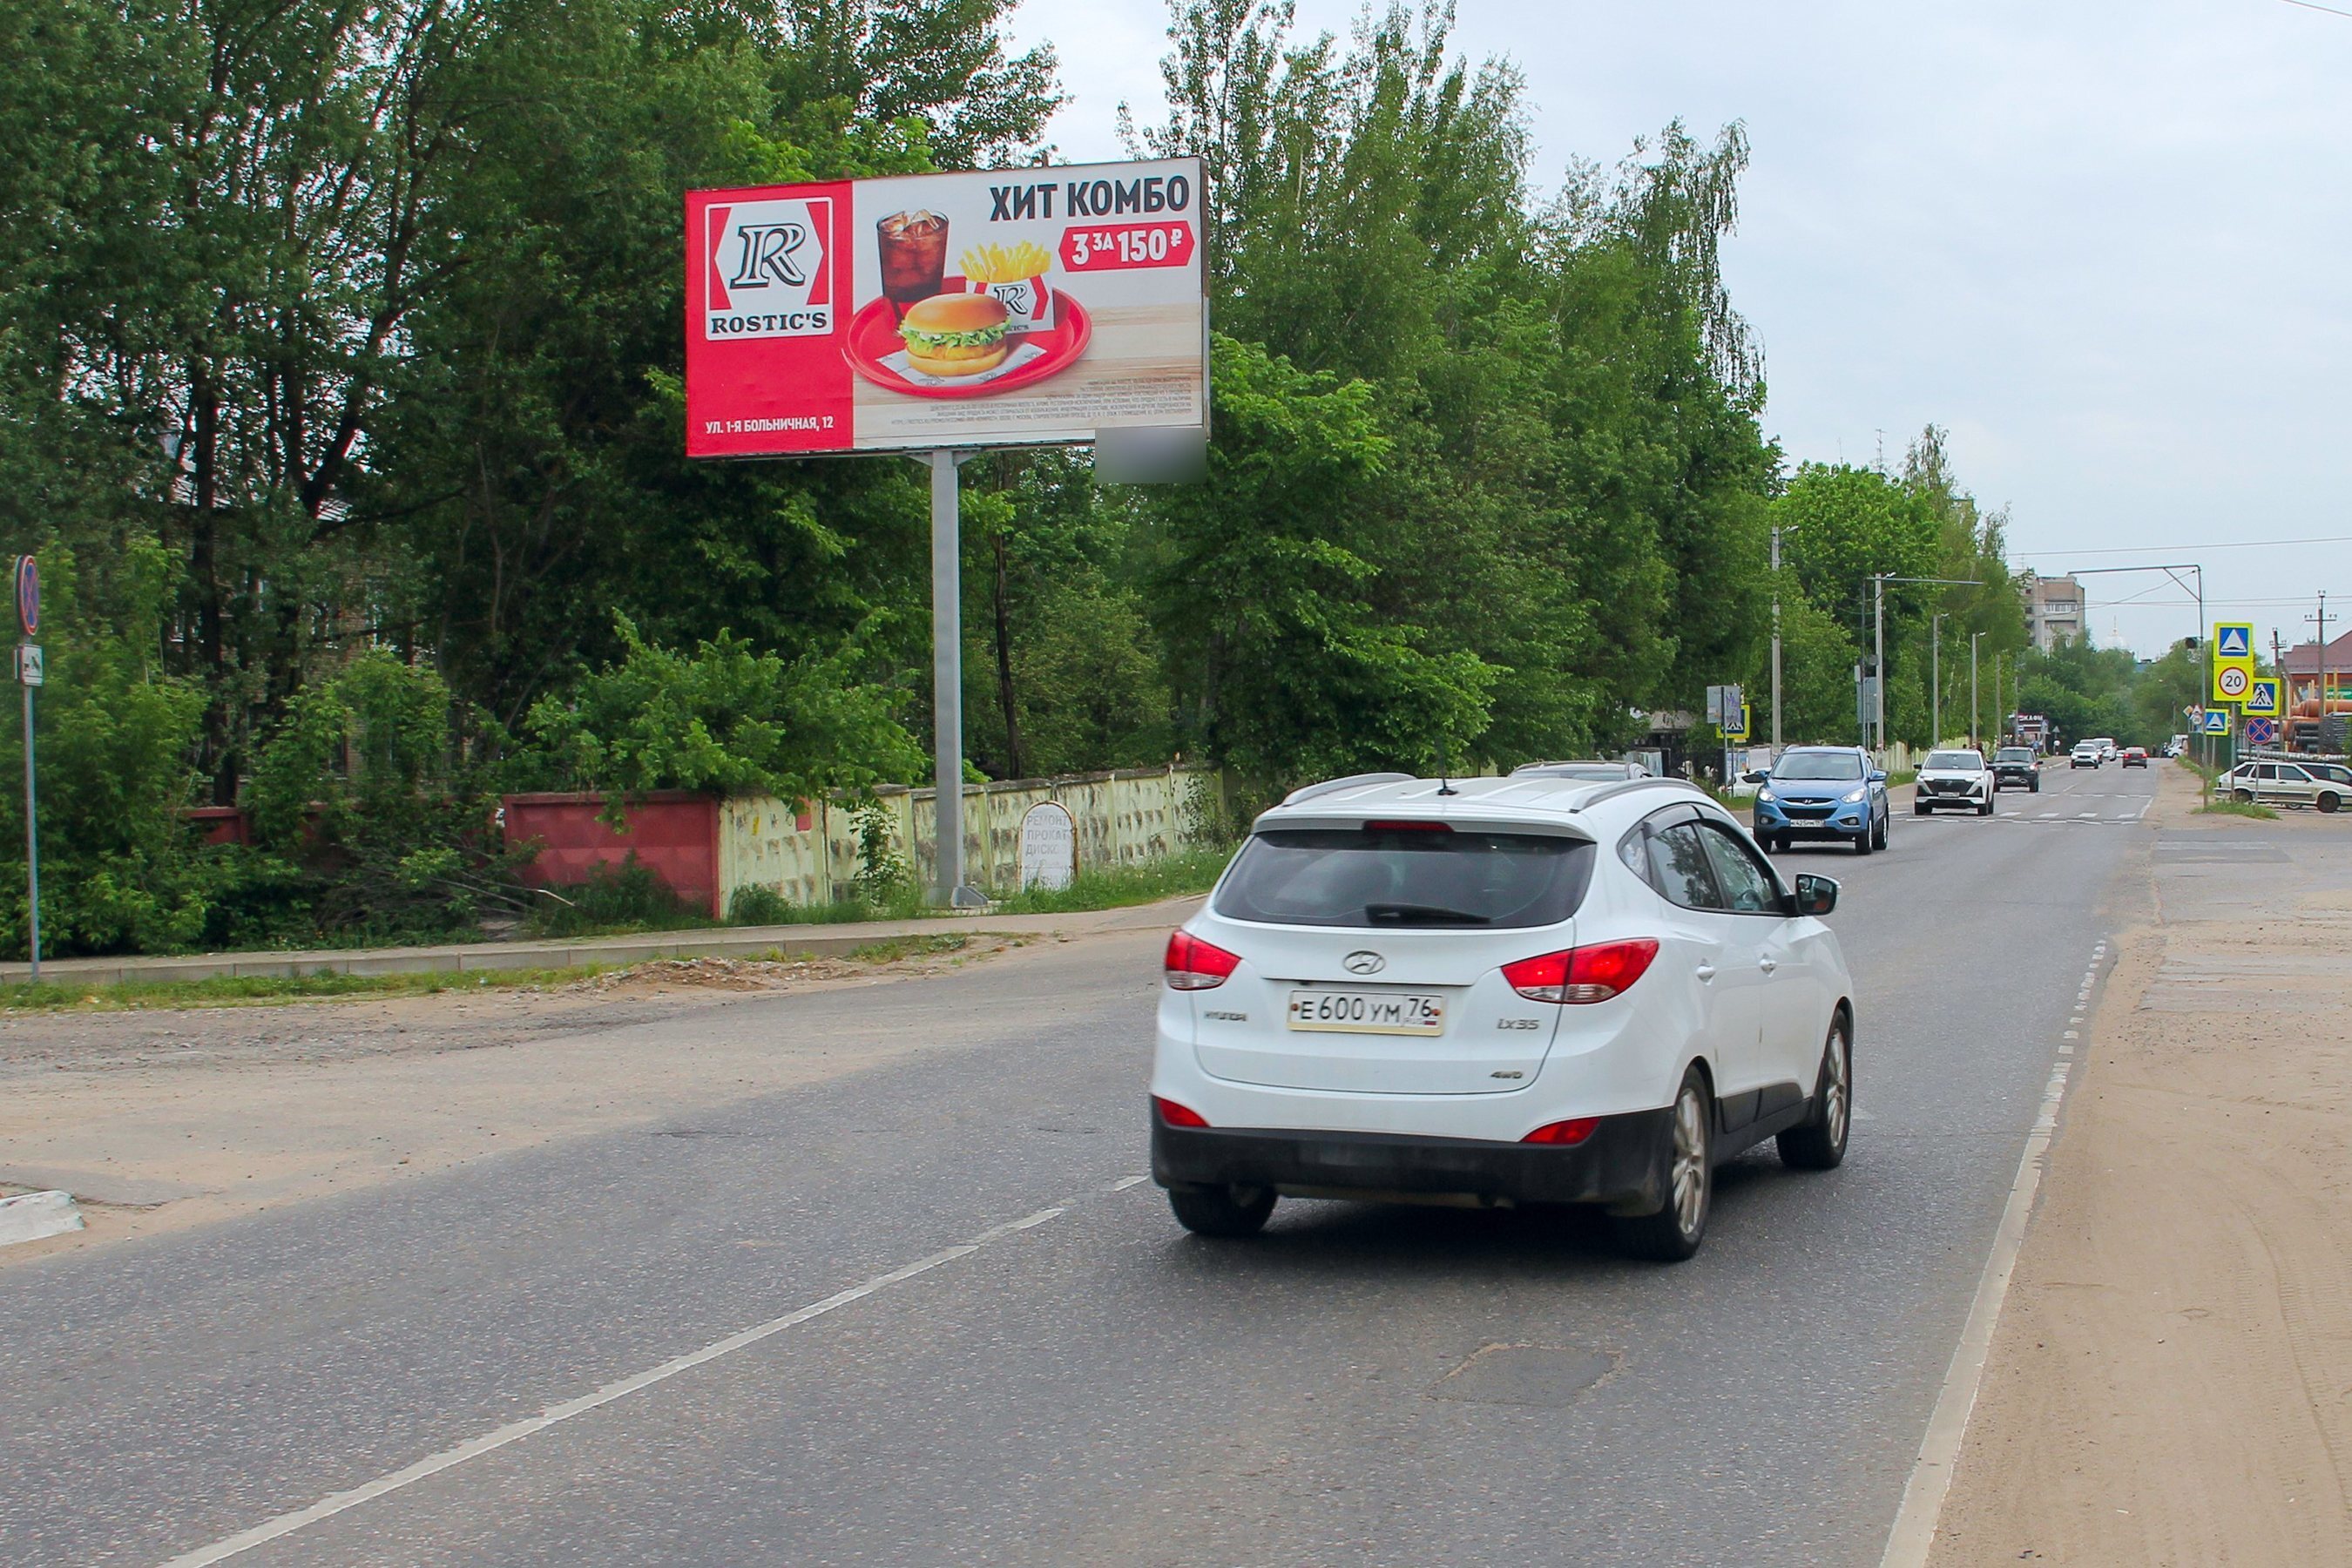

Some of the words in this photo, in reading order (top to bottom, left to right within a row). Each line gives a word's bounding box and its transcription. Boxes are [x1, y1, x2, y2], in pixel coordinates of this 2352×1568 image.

[990, 183, 1058, 221] ХИТ
[1067, 175, 1189, 217] КОМБО
[1071, 233, 1090, 265] 3
[711, 312, 827, 334] ROSTIC'S
[706, 421, 724, 434] УЛ.
[726, 420, 741, 433] 1-Я
[744, 416, 820, 432] БОЛЬНИЧНАЯ,
[822, 416, 834, 429] 12
[2225, 675, 2241, 687] 20
[1026, 815, 1068, 826] РЕМОНТ
[1027, 829, 1068, 841] ПРОКАТ
